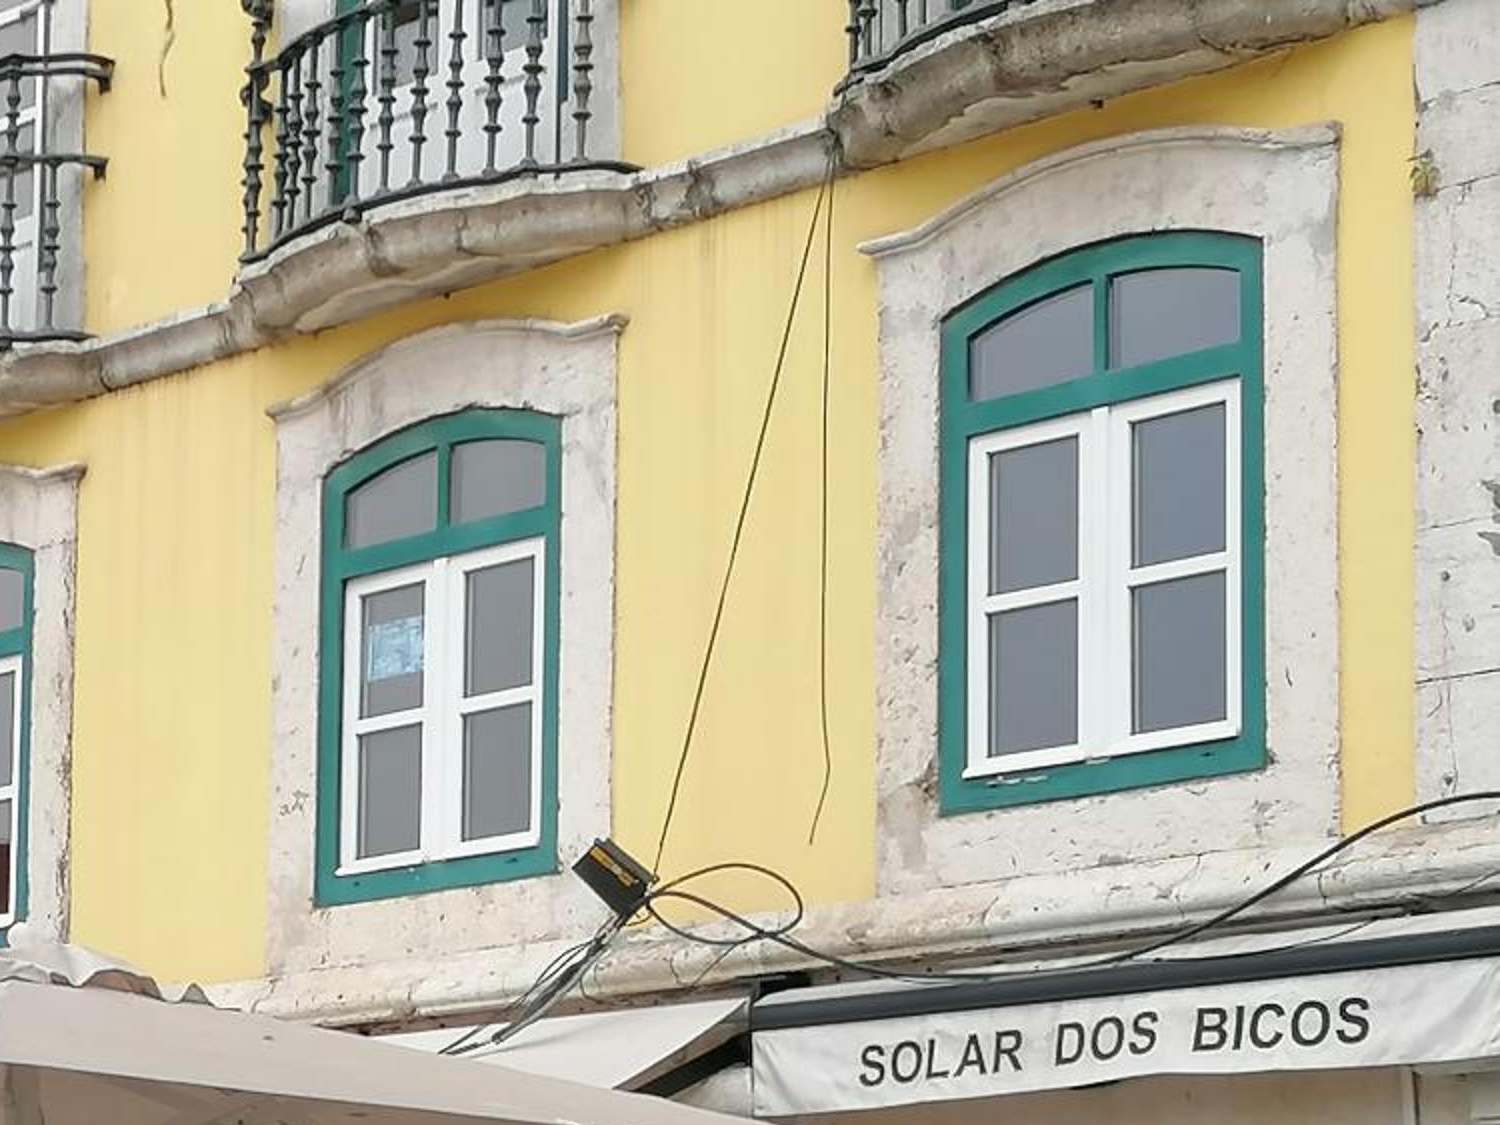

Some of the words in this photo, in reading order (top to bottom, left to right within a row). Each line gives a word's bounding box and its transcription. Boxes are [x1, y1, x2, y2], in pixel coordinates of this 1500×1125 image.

[859, 1029, 1023, 1087] SOLAR
[1055, 1011, 1158, 1066] DOS
[1192, 997, 1370, 1051] BICOS
